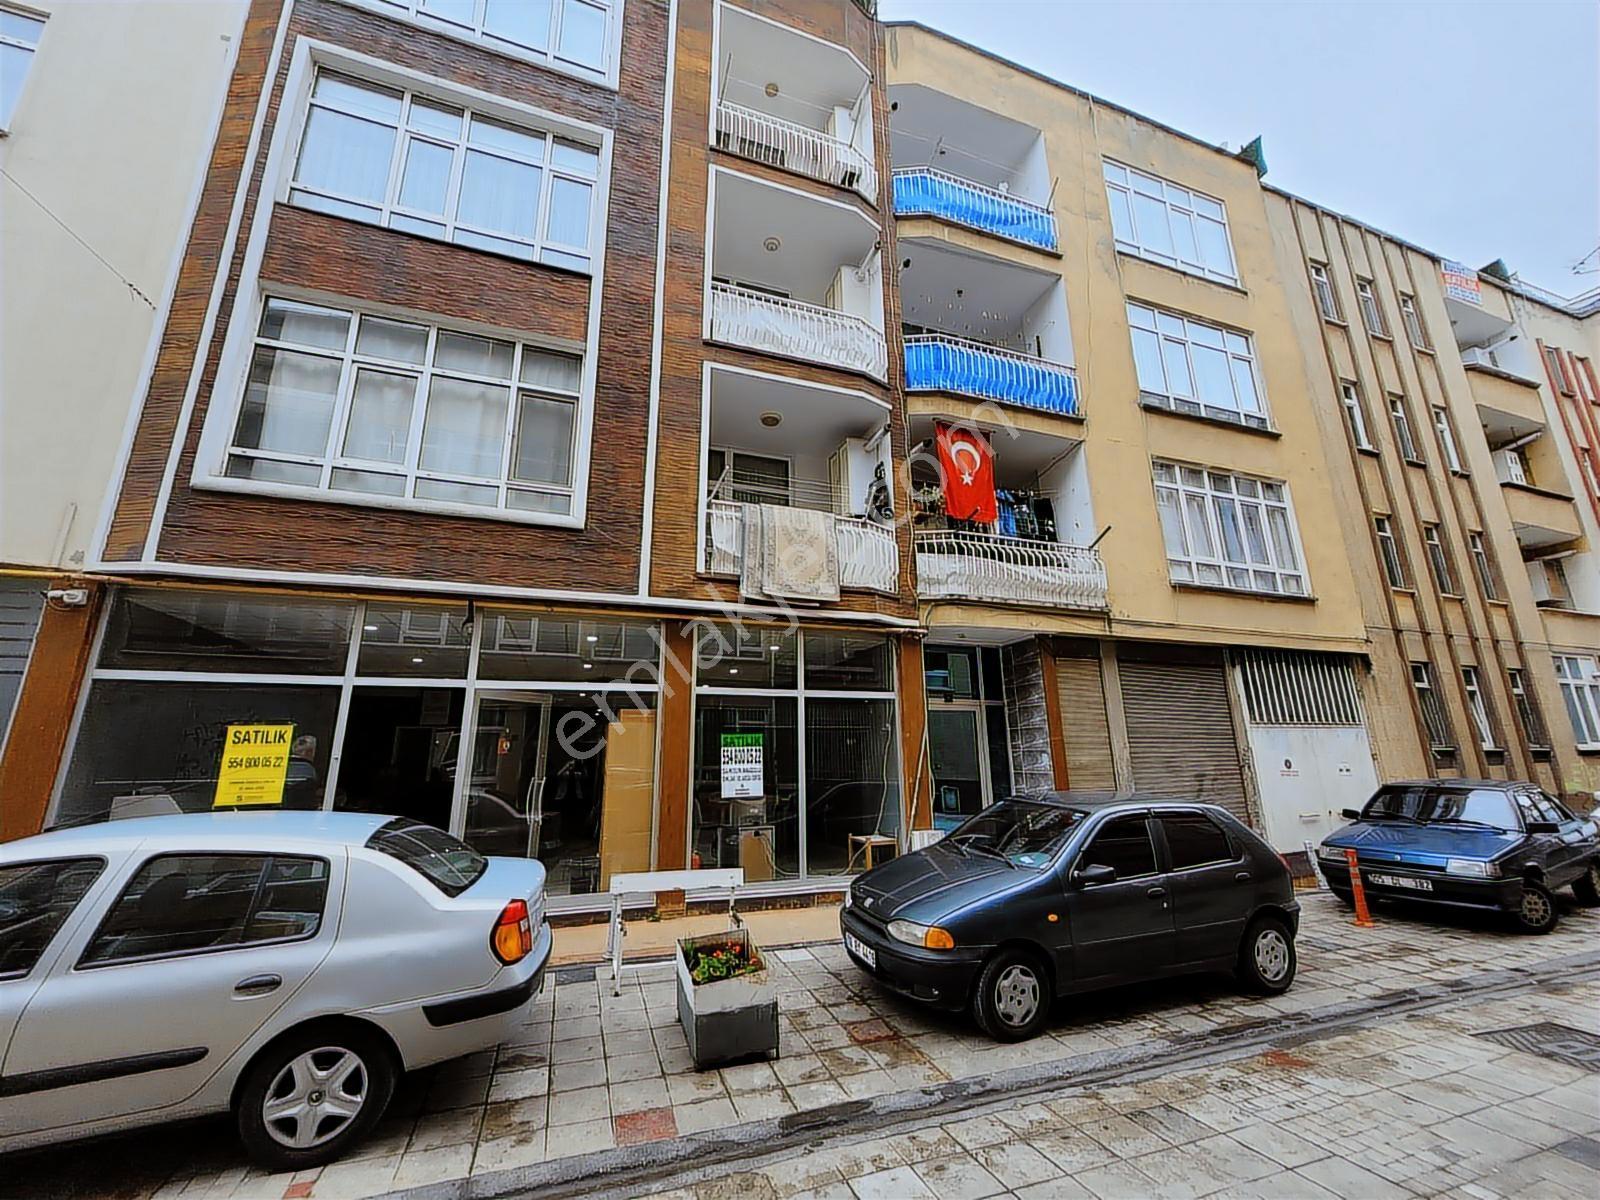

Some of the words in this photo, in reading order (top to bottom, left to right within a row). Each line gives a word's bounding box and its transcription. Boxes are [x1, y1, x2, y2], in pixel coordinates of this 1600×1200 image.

[232, 730, 288, 744] SATILIK
[228, 757, 243, 768] 554
[273, 756, 284, 768] 22
